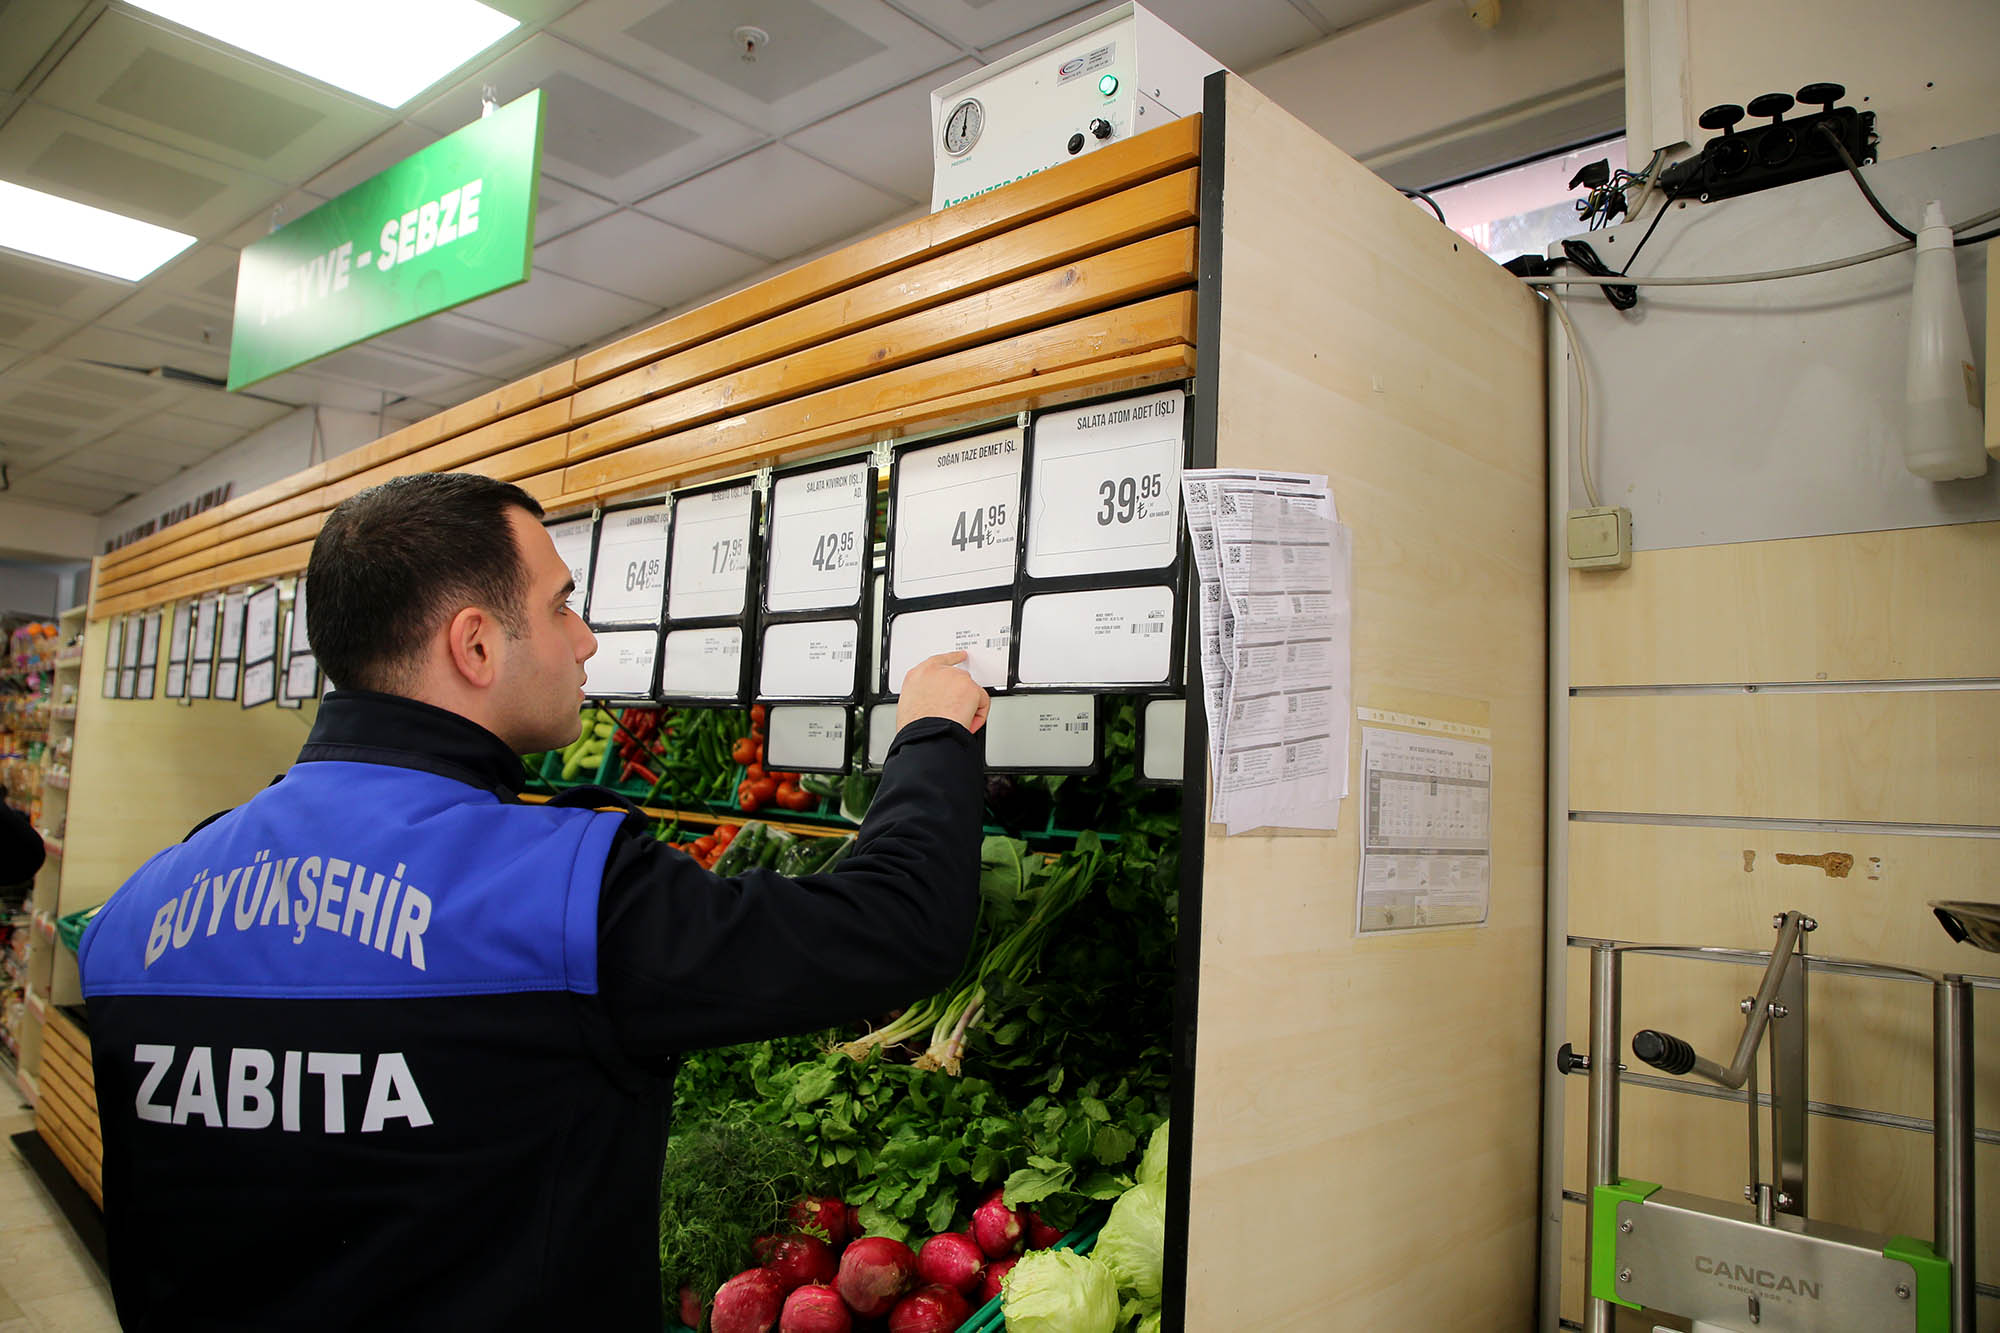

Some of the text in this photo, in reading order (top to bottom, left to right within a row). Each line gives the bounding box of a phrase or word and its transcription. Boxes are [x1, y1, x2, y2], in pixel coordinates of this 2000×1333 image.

[260, 240, 353, 326] EYVE
[377, 178, 483, 272] SEBZE
[1077, 413, 1106, 430] SALATA
[1108, 408, 1130, 425] ATOM
[1132, 404, 1153, 420] ADET
[937, 452, 960, 468] SOĞAN
[961, 448, 978, 462] TAZE
[979, 442, 1003, 459] DEMET
[1097, 473, 1161, 526] 39,95
[951, 503, 1006, 552] 44,95
[712, 538, 743, 574] 17,95
[812, 531, 854, 572] 42,95
[625, 559, 660, 592] 64,95
[144, 849, 433, 972] BÜYÜKŞEHİR
[134, 1043, 434, 1133] ZABITA
[1695, 1255, 1820, 1300] CANCAN
